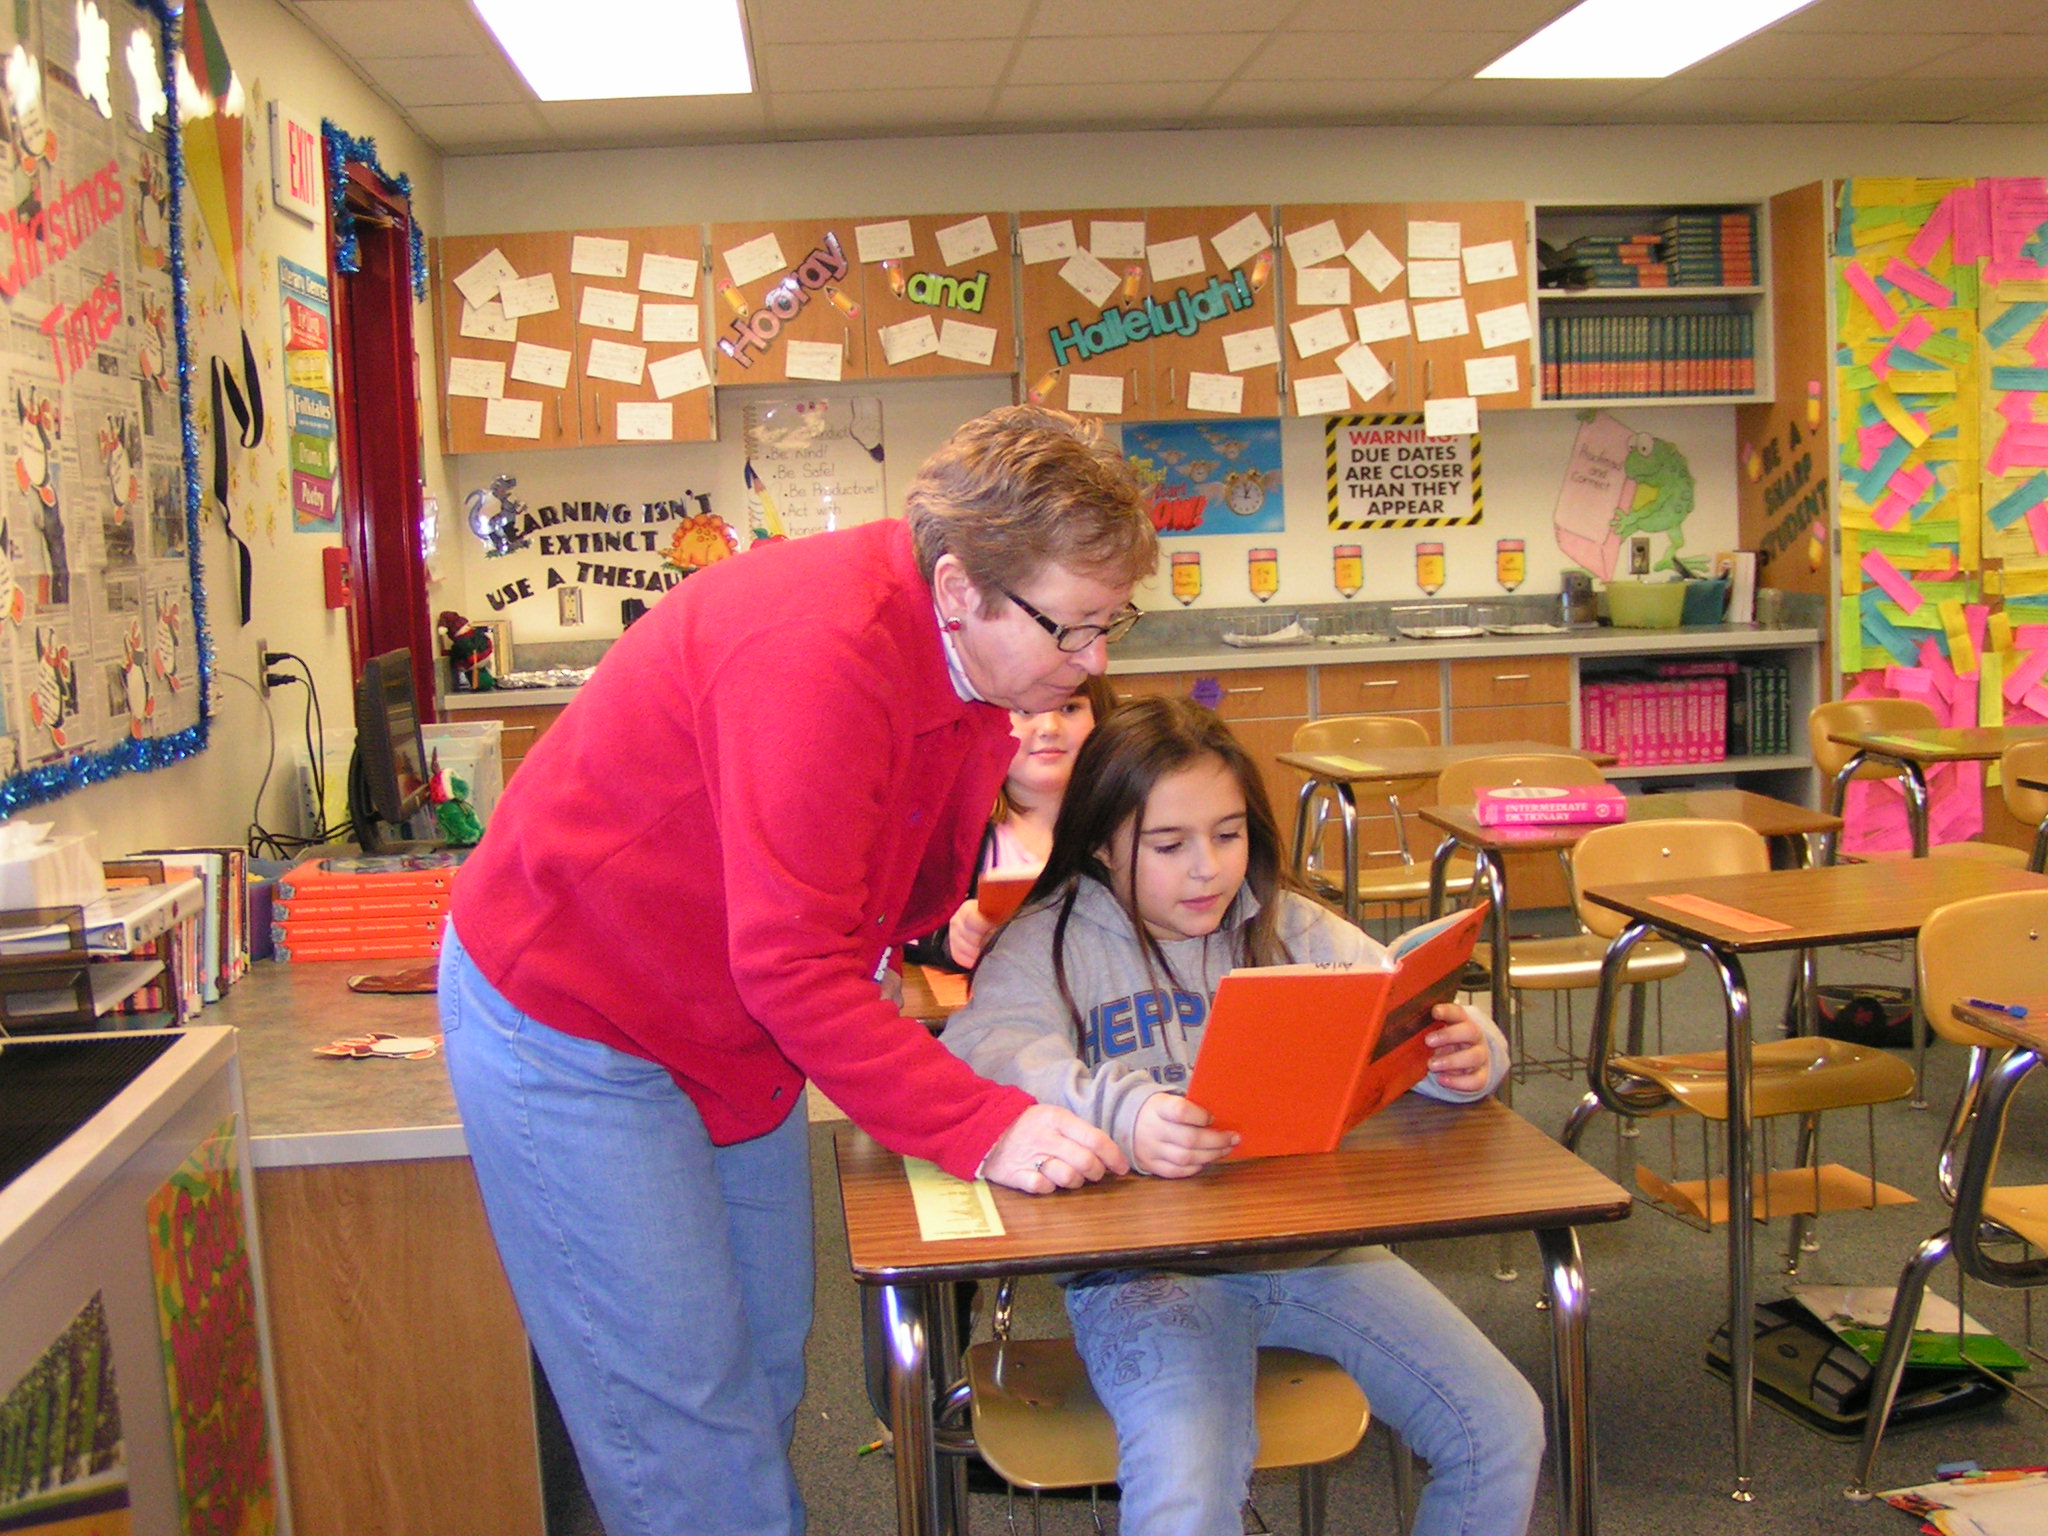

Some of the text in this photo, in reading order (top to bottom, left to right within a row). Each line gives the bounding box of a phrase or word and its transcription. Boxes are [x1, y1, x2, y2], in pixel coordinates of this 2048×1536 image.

[288, 120, 315, 207] EXIT
[717, 231, 848, 369] Hooray
[908, 269, 989, 313] and
[41, 271, 122, 385] Times
[1050, 268, 1254, 366] Hallelujah!
[295, 393, 332, 420] Folktales
[1351, 445, 1457, 463] DUE DATES
[778, 462, 835, 479] Be Safe!
[1345, 463, 1464, 481] ARE CLOSER
[302, 480, 325, 512] Poetry
[789, 480, 879, 498] Be Productive!
[1348, 480, 1461, 499] THAN THEY
[642, 489, 712, 524] ISN'T
[787, 503, 808, 516] Act
[1367, 499, 1445, 516] APPEAR
[540, 530, 659, 556] EXTINCT
[486, 561, 698, 612] USE A THESAU
[1505, 802, 1589, 813] INTERMEDIATE
[1505, 812, 1570, 823] DICTIONARY
[1084, 988, 1216, 1068] HEPP
